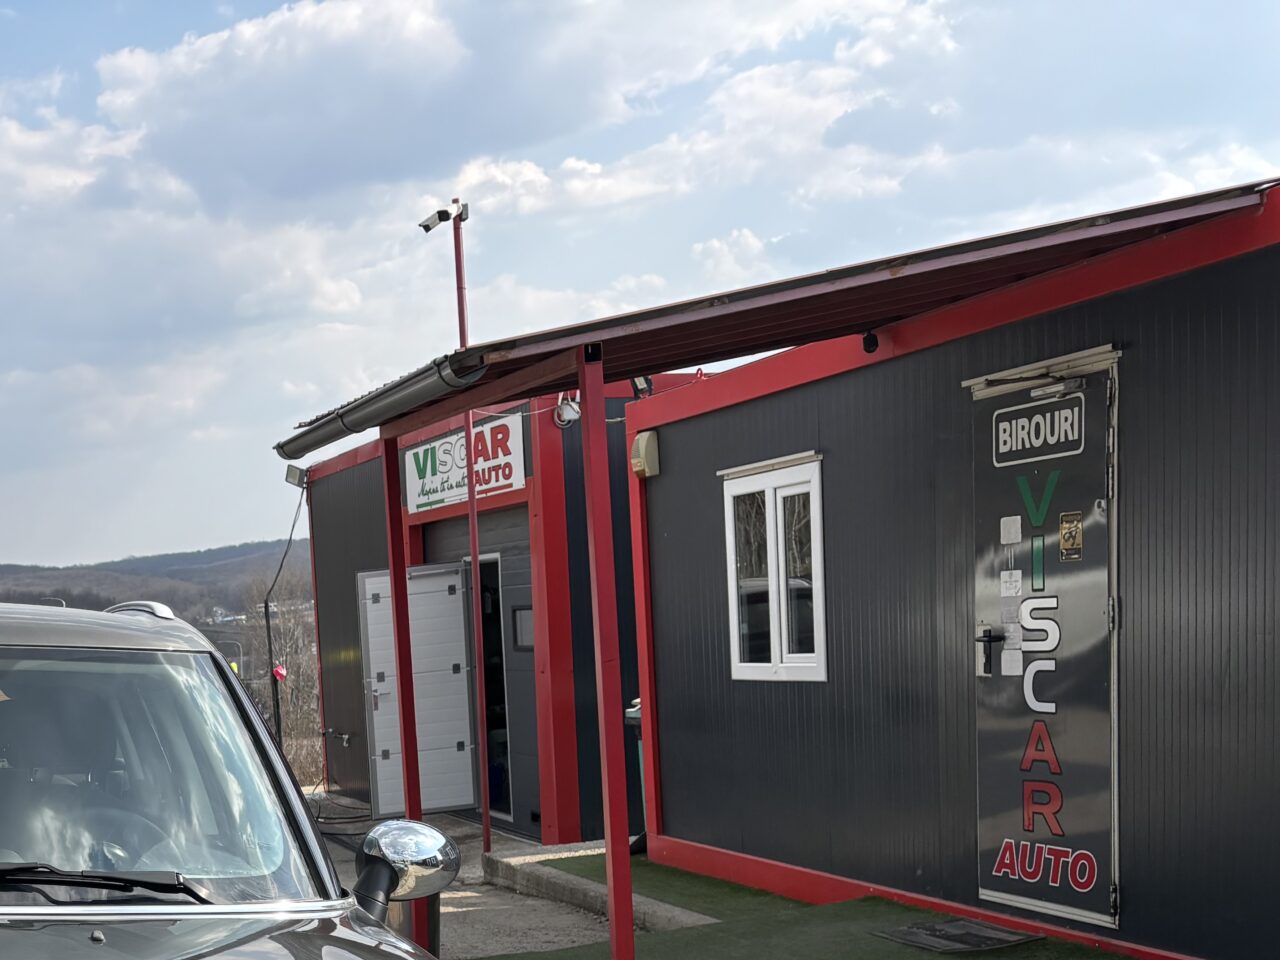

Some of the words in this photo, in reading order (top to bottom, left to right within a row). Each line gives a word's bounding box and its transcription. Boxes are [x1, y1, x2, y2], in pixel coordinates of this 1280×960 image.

[412, 423, 512, 480] VISCAR
[998, 406, 1079, 453] BIROURI
[474, 461, 513, 487] AUTO
[1017, 470, 1064, 837] VISCAR
[992, 838, 1098, 892] AUTO
